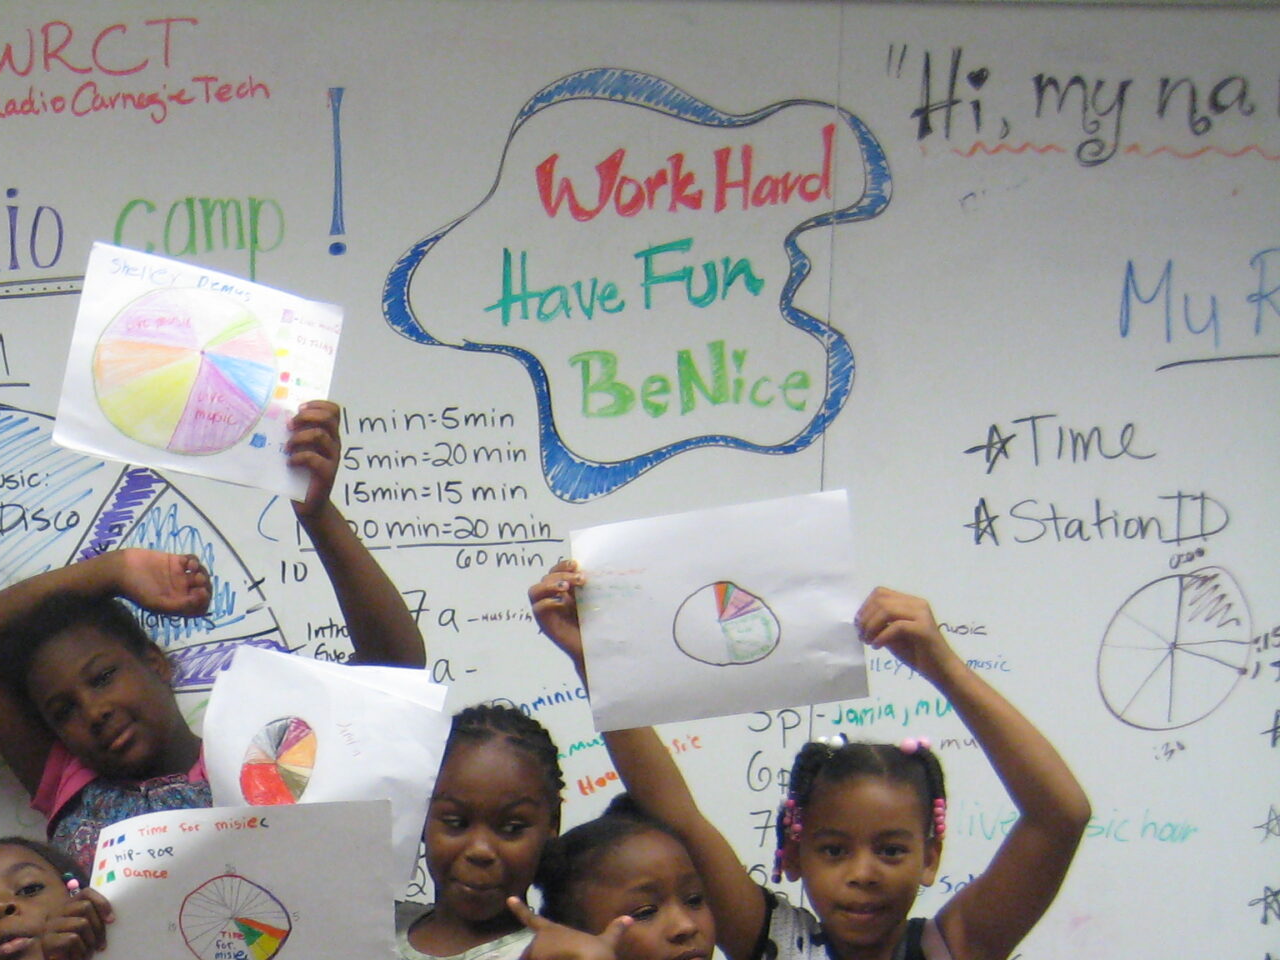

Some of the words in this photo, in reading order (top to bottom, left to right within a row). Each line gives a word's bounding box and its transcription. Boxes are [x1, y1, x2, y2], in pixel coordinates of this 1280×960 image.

[192, 75, 271, 104] Tech
[1032, 72, 1133, 167] my
[535, 148, 705, 222] Work
[712, 123, 837, 214] Hard
[114, 195, 285, 283] camp
[483, 248, 626, 326] Have
[634, 237, 765, 310] Fun
[1120, 258, 1219, 348] My
[569, 350, 671, 419] Be
[677, 339, 812, 416] Nice
[1011, 413, 1157, 467] Time
[1008, 497, 1166, 544] Station
[1157, 490, 1231, 548] ID
